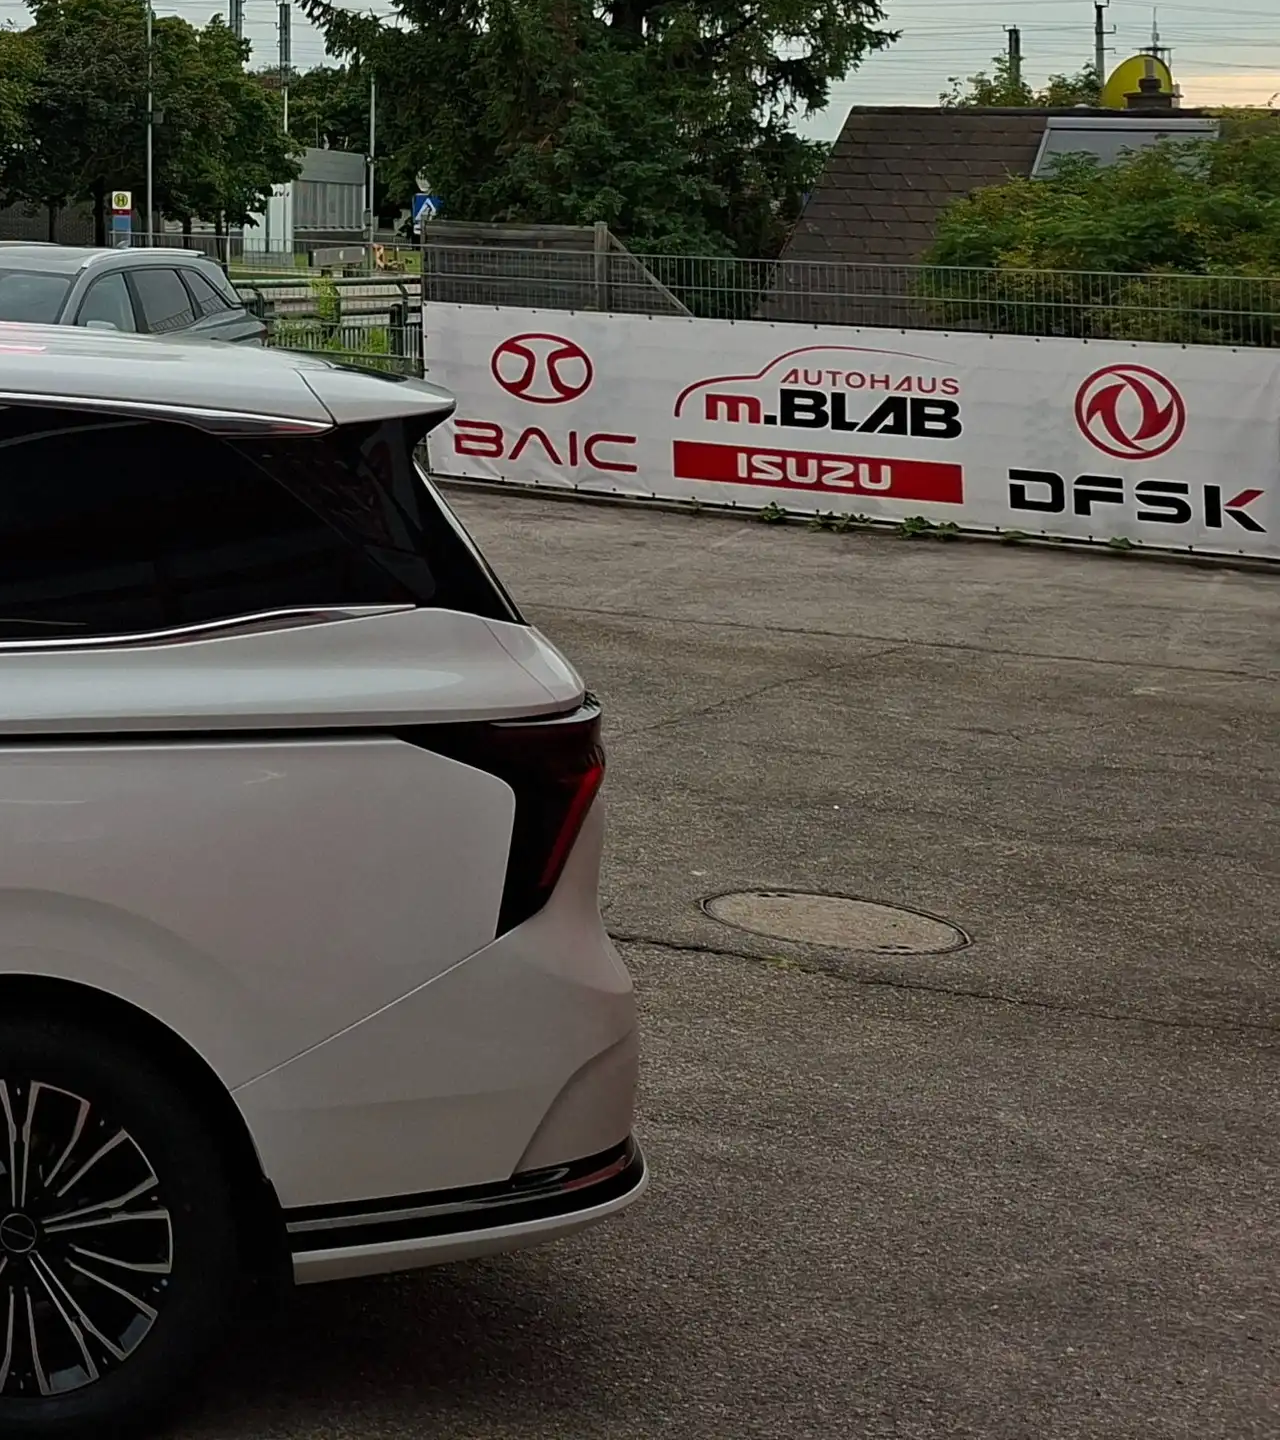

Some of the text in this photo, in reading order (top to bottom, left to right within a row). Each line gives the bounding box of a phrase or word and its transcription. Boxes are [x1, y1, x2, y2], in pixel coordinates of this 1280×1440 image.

[780, 368, 960, 396] AUTOHAUS
[705, 388, 963, 440] m.BLAB
[454, 419, 638, 473] BAIC
[737, 452, 891, 491] ISUZU
[1008, 468, 1267, 533] DFSK
